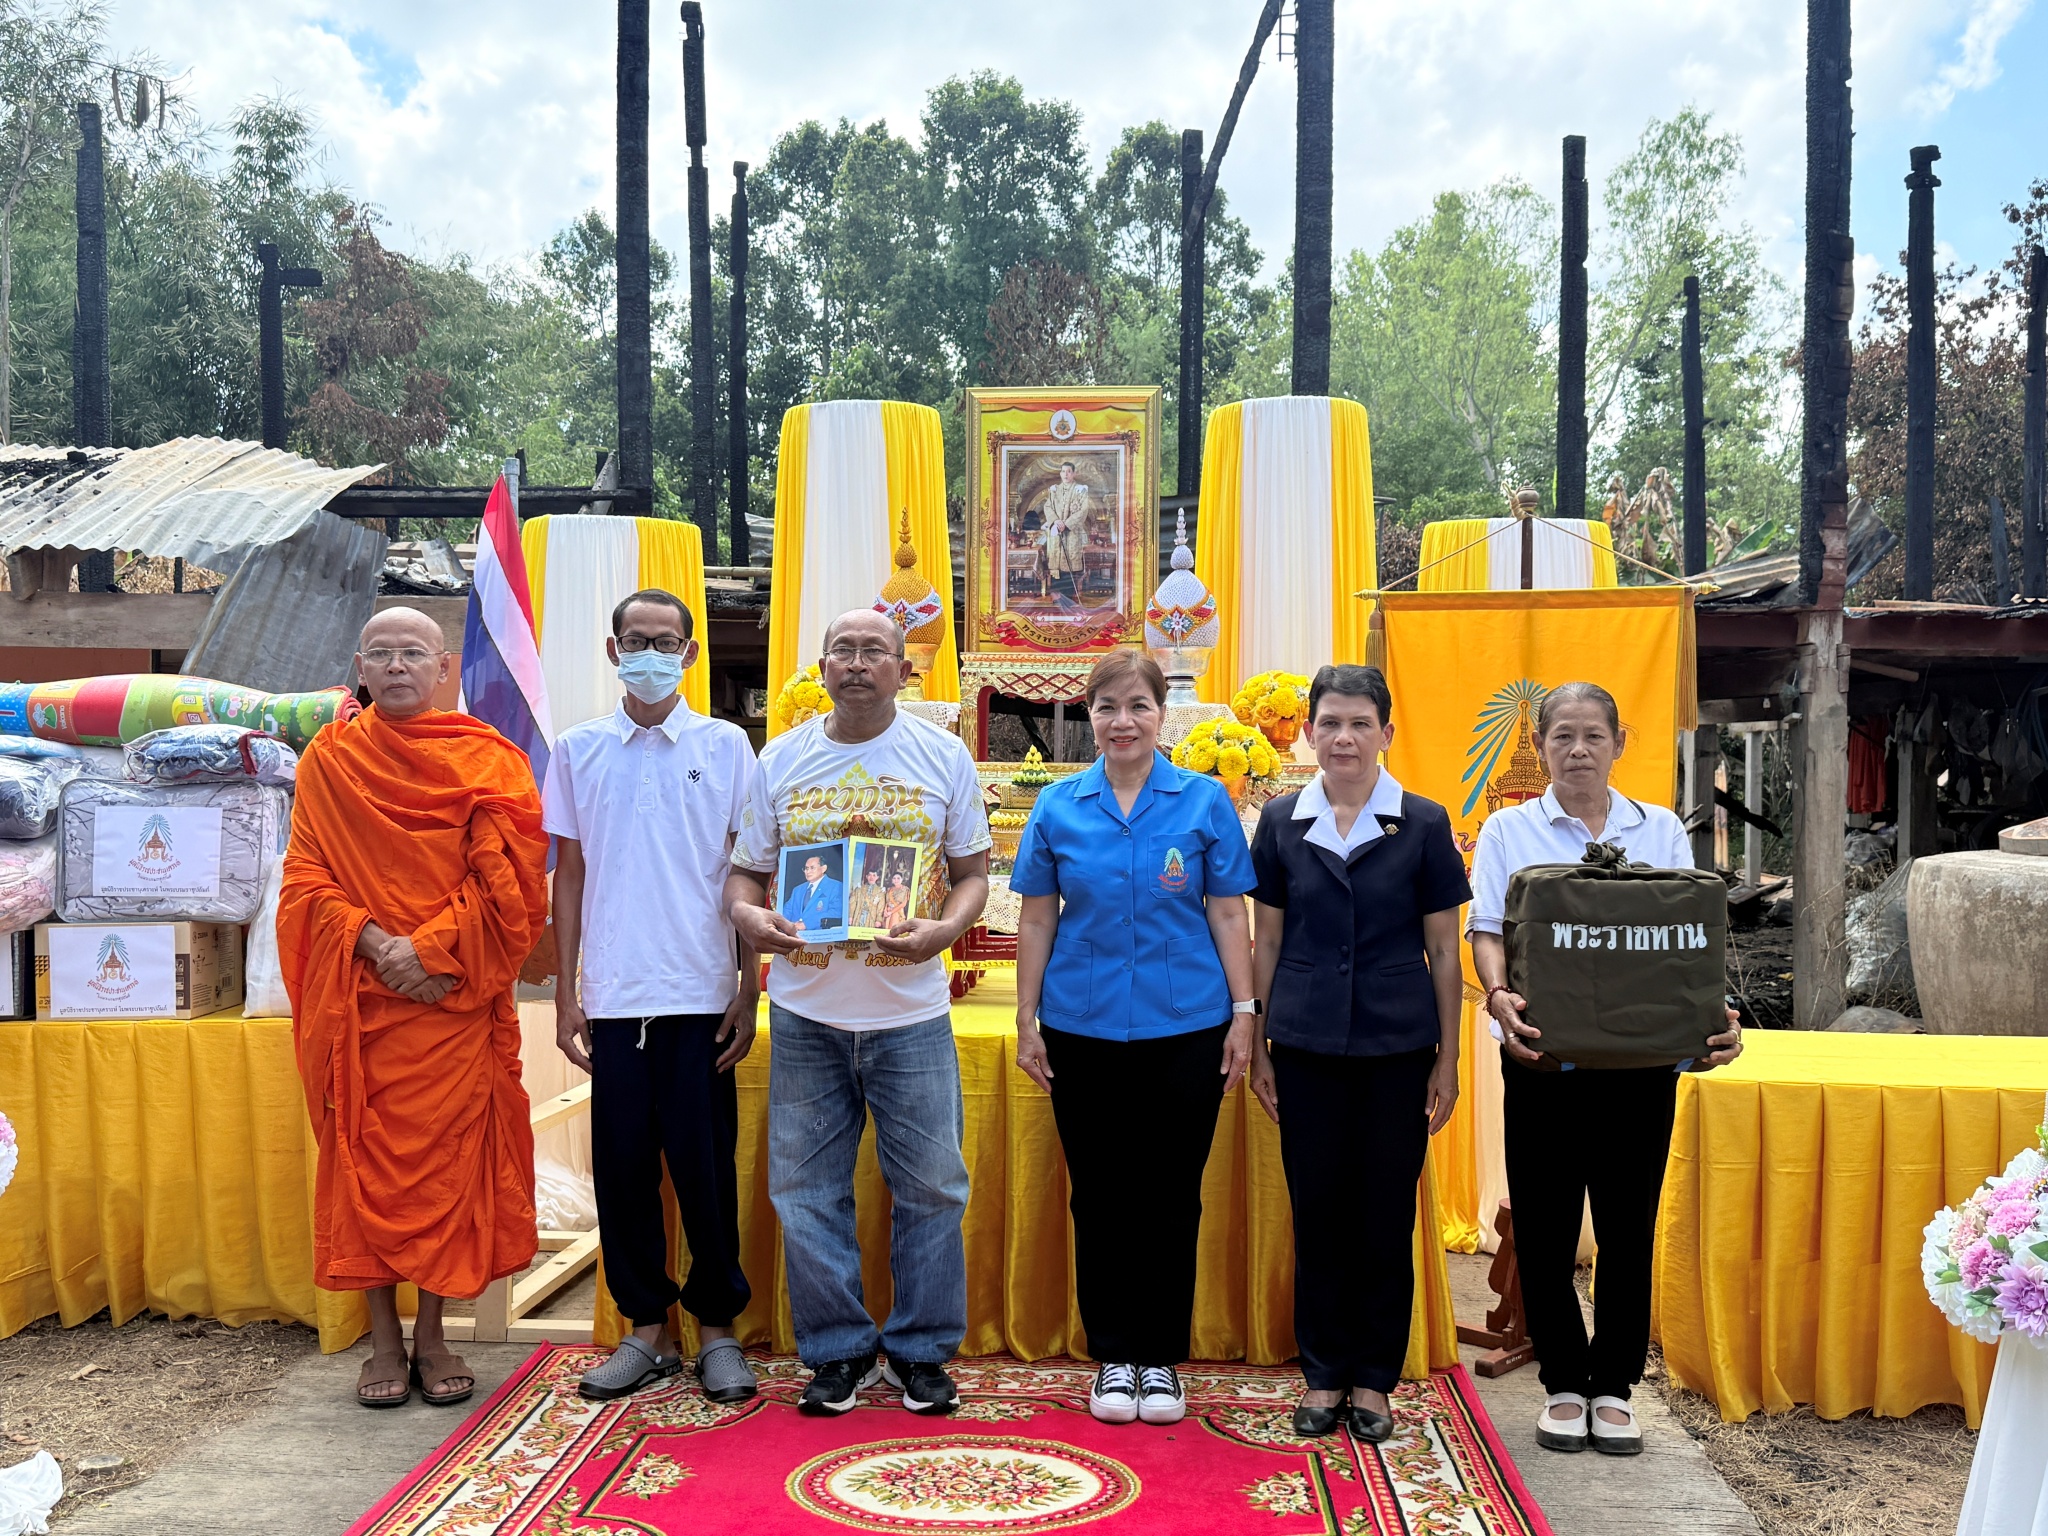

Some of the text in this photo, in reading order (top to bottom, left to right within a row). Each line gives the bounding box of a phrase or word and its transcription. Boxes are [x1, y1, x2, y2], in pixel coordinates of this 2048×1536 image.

[786, 774, 926, 817] มหากฐิน
[1551, 921, 1708, 950] พระราชทาน
